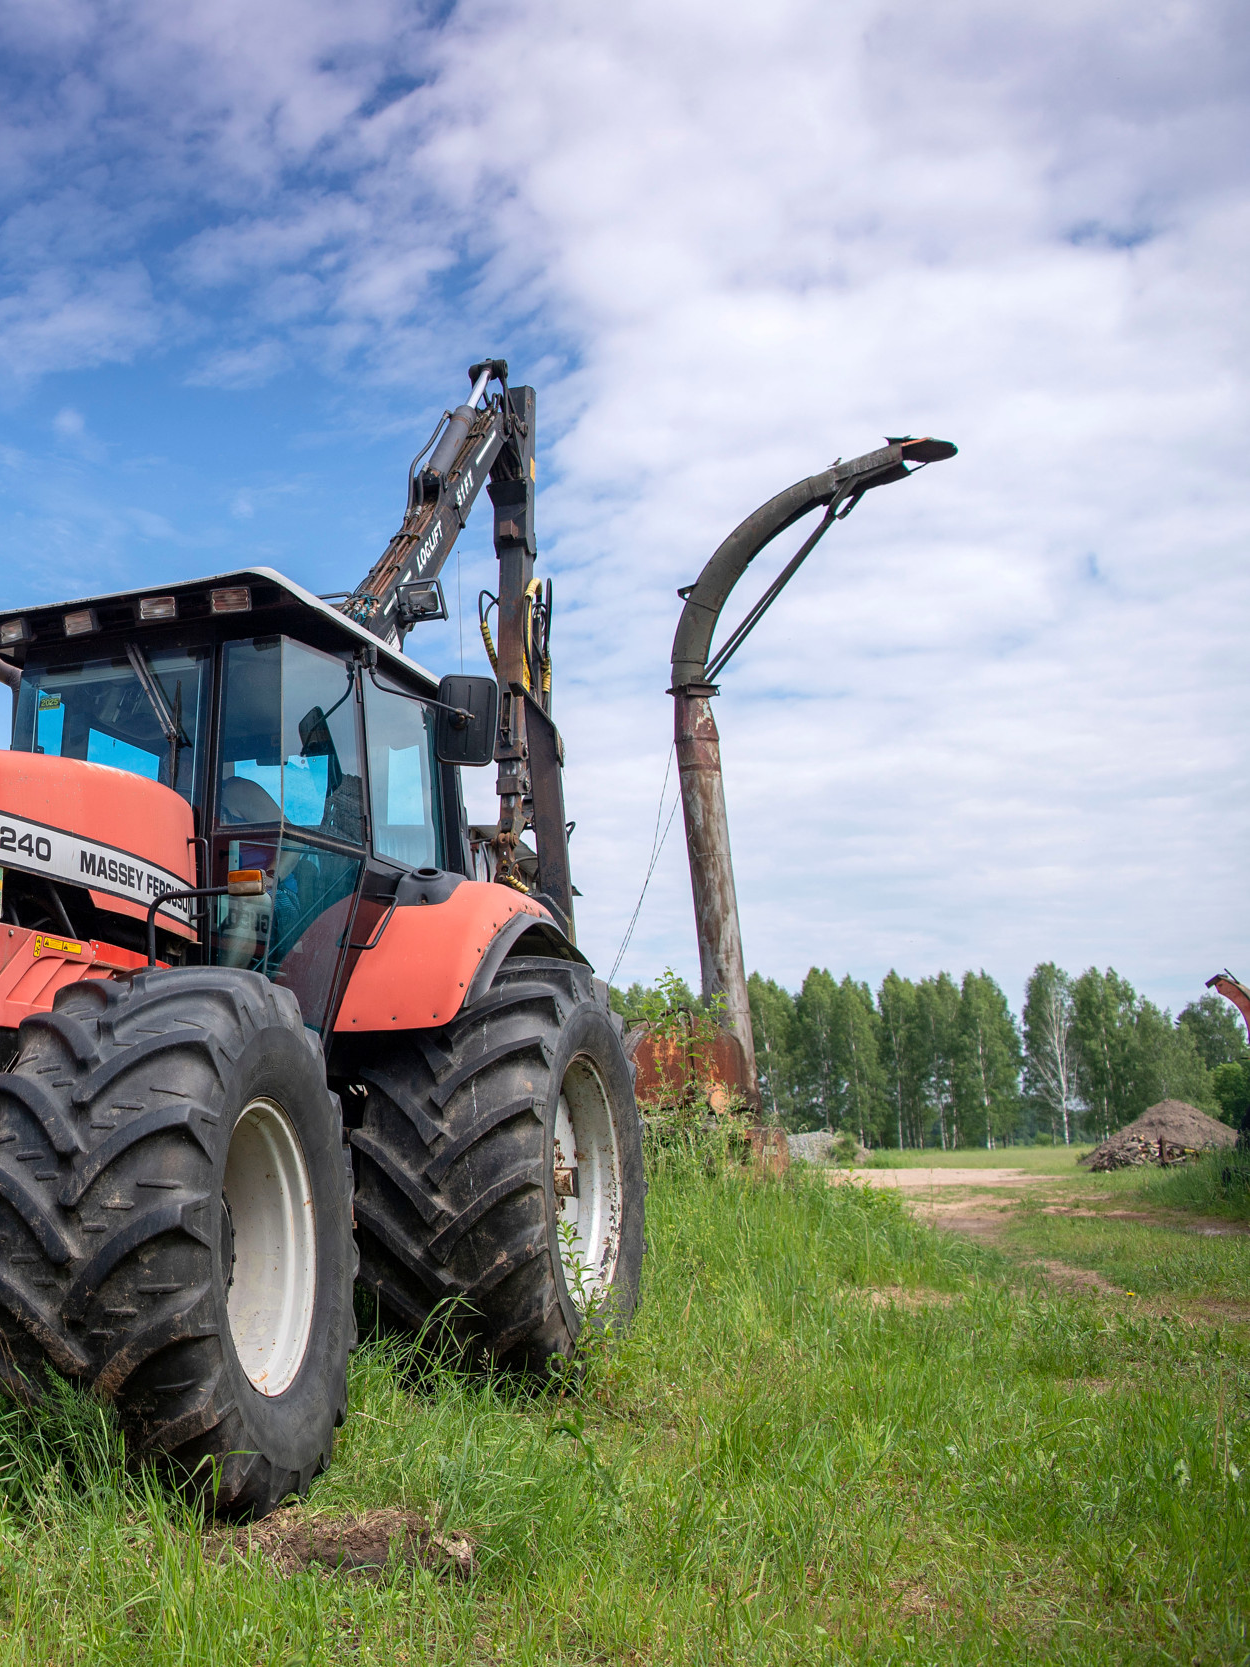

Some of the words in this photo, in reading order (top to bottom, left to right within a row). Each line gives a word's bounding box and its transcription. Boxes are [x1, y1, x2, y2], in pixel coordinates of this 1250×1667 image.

[416, 519, 443, 572] LOGLIFT
[41, 698, 59, 707] 2025
[80, 850, 143, 890] MASSEY
